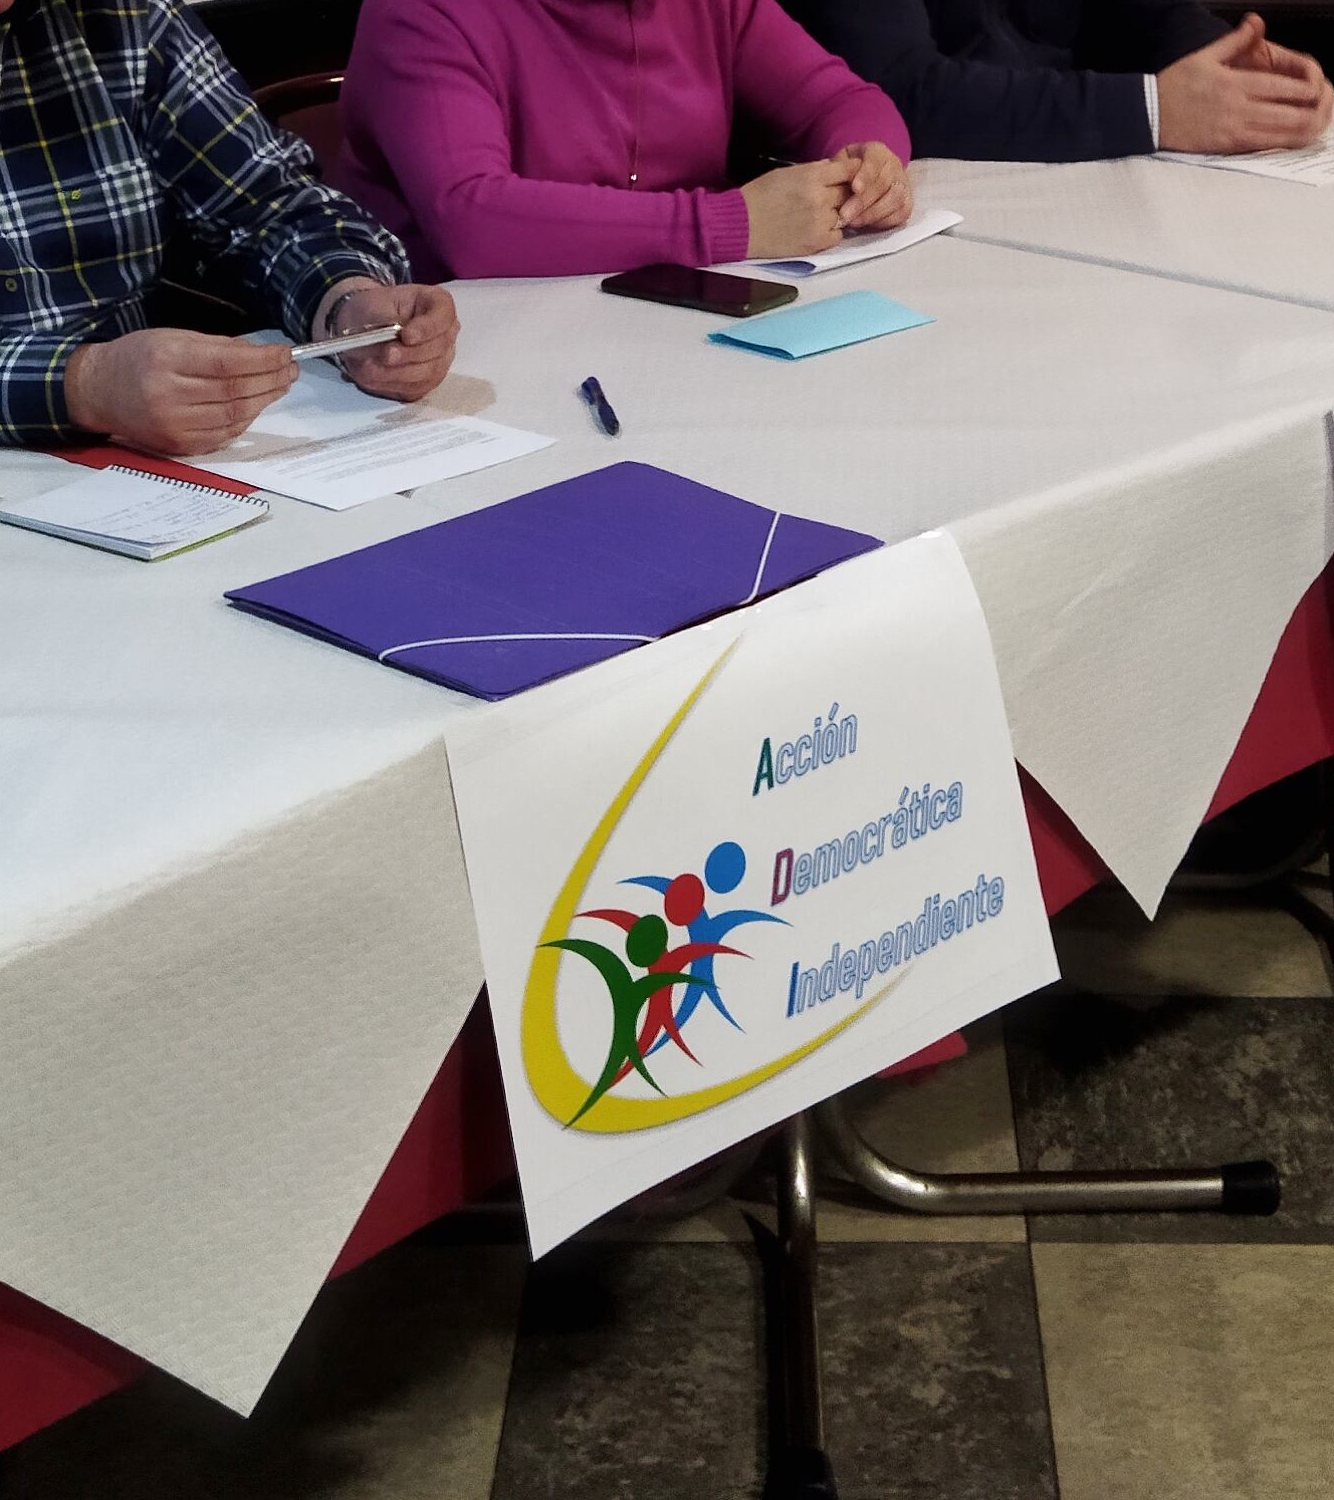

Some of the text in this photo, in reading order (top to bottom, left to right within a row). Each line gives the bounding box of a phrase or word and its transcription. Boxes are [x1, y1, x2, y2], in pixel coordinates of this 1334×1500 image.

[752, 702, 859, 797] Acción
[770, 781, 964, 907] Democrática
[785, 874, 1006, 1019] Independiente
